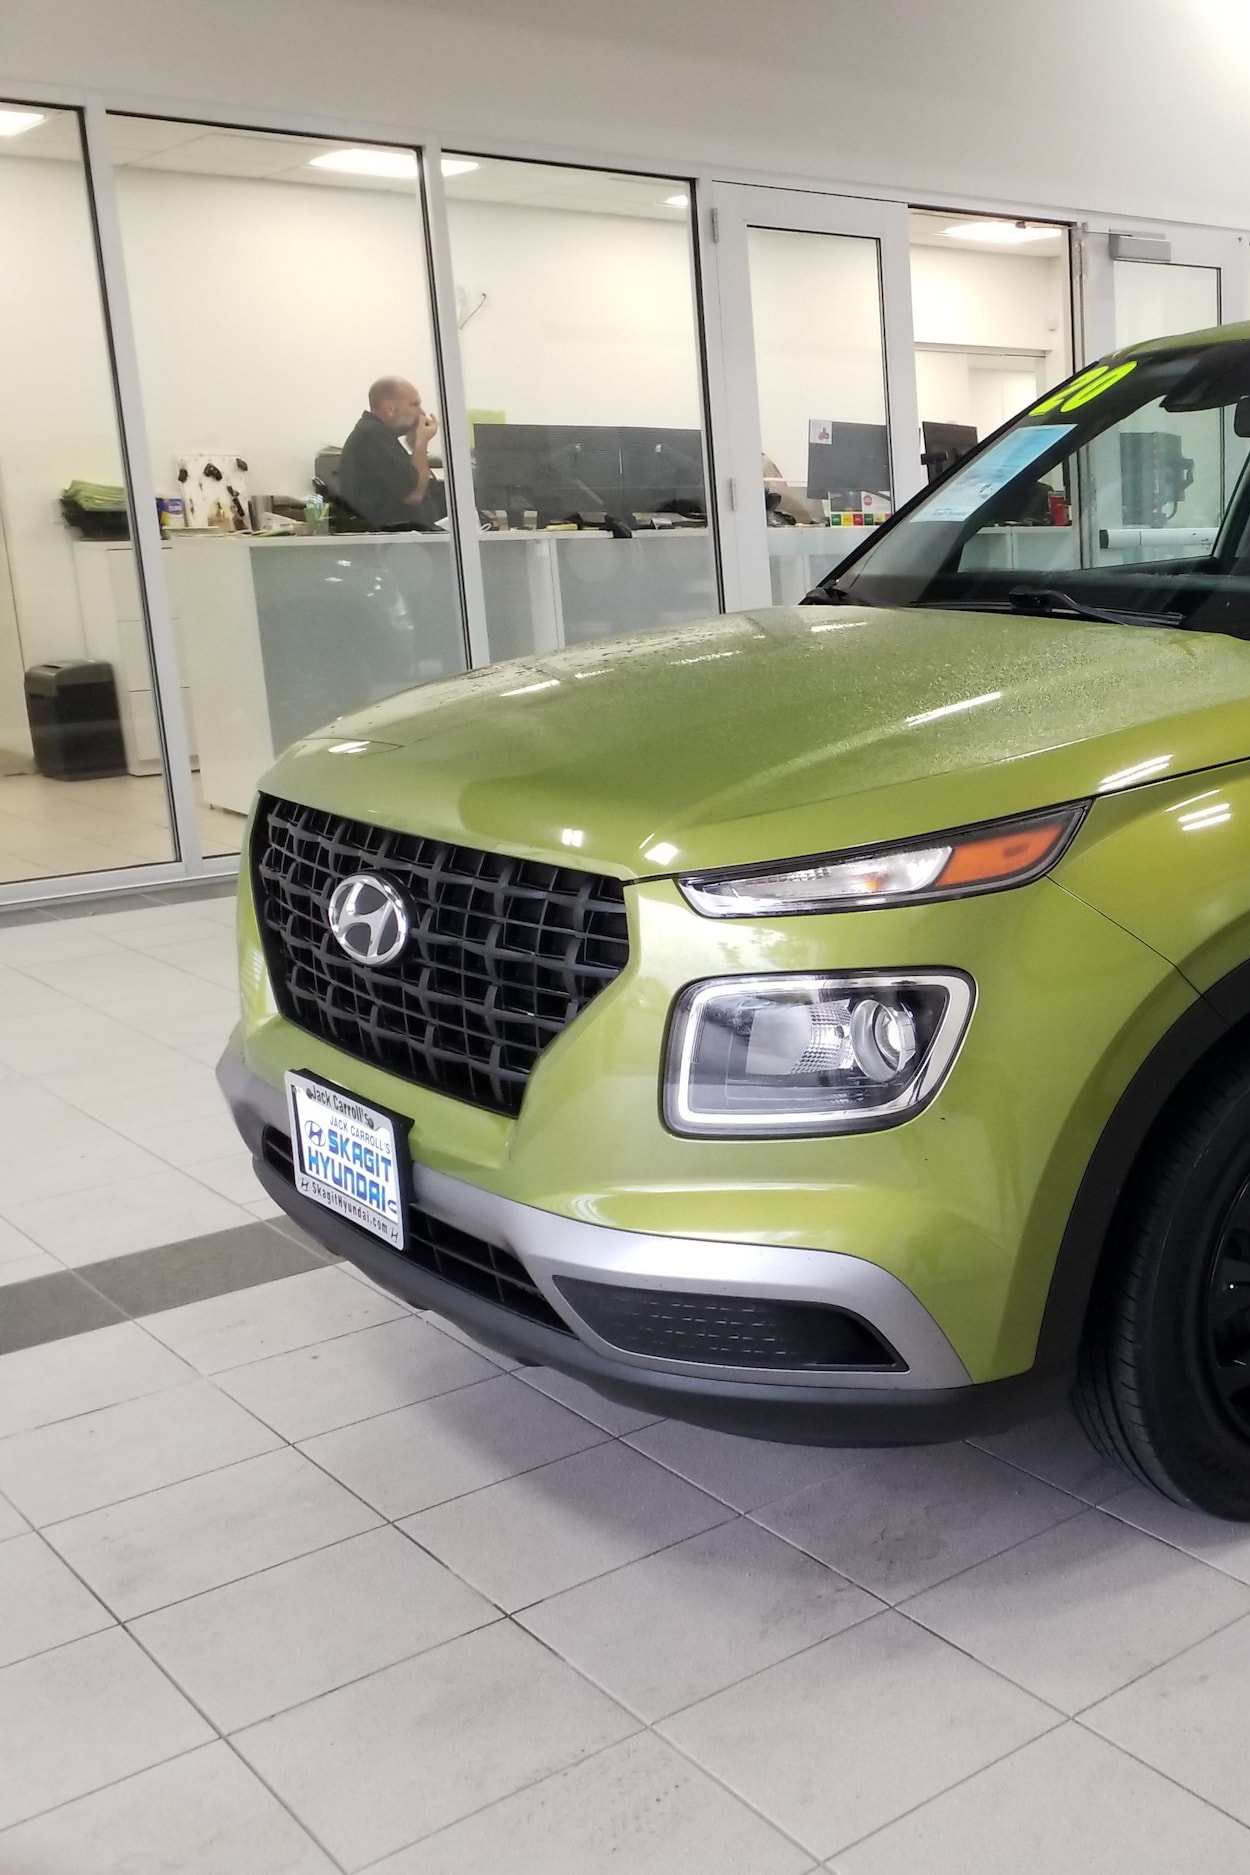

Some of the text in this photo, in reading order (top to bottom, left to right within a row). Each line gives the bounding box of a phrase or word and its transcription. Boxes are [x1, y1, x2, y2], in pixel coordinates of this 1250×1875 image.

[311, 1085, 370, 1123] Jack Carroll's
[328, 1129, 391, 1183] SKAGIT
[330, 1116, 391, 1155] JACK CARROLL'S
[309, 1146, 385, 1213] HYUNDAI
[312, 1181, 388, 1234] SkagitHyundai.com
